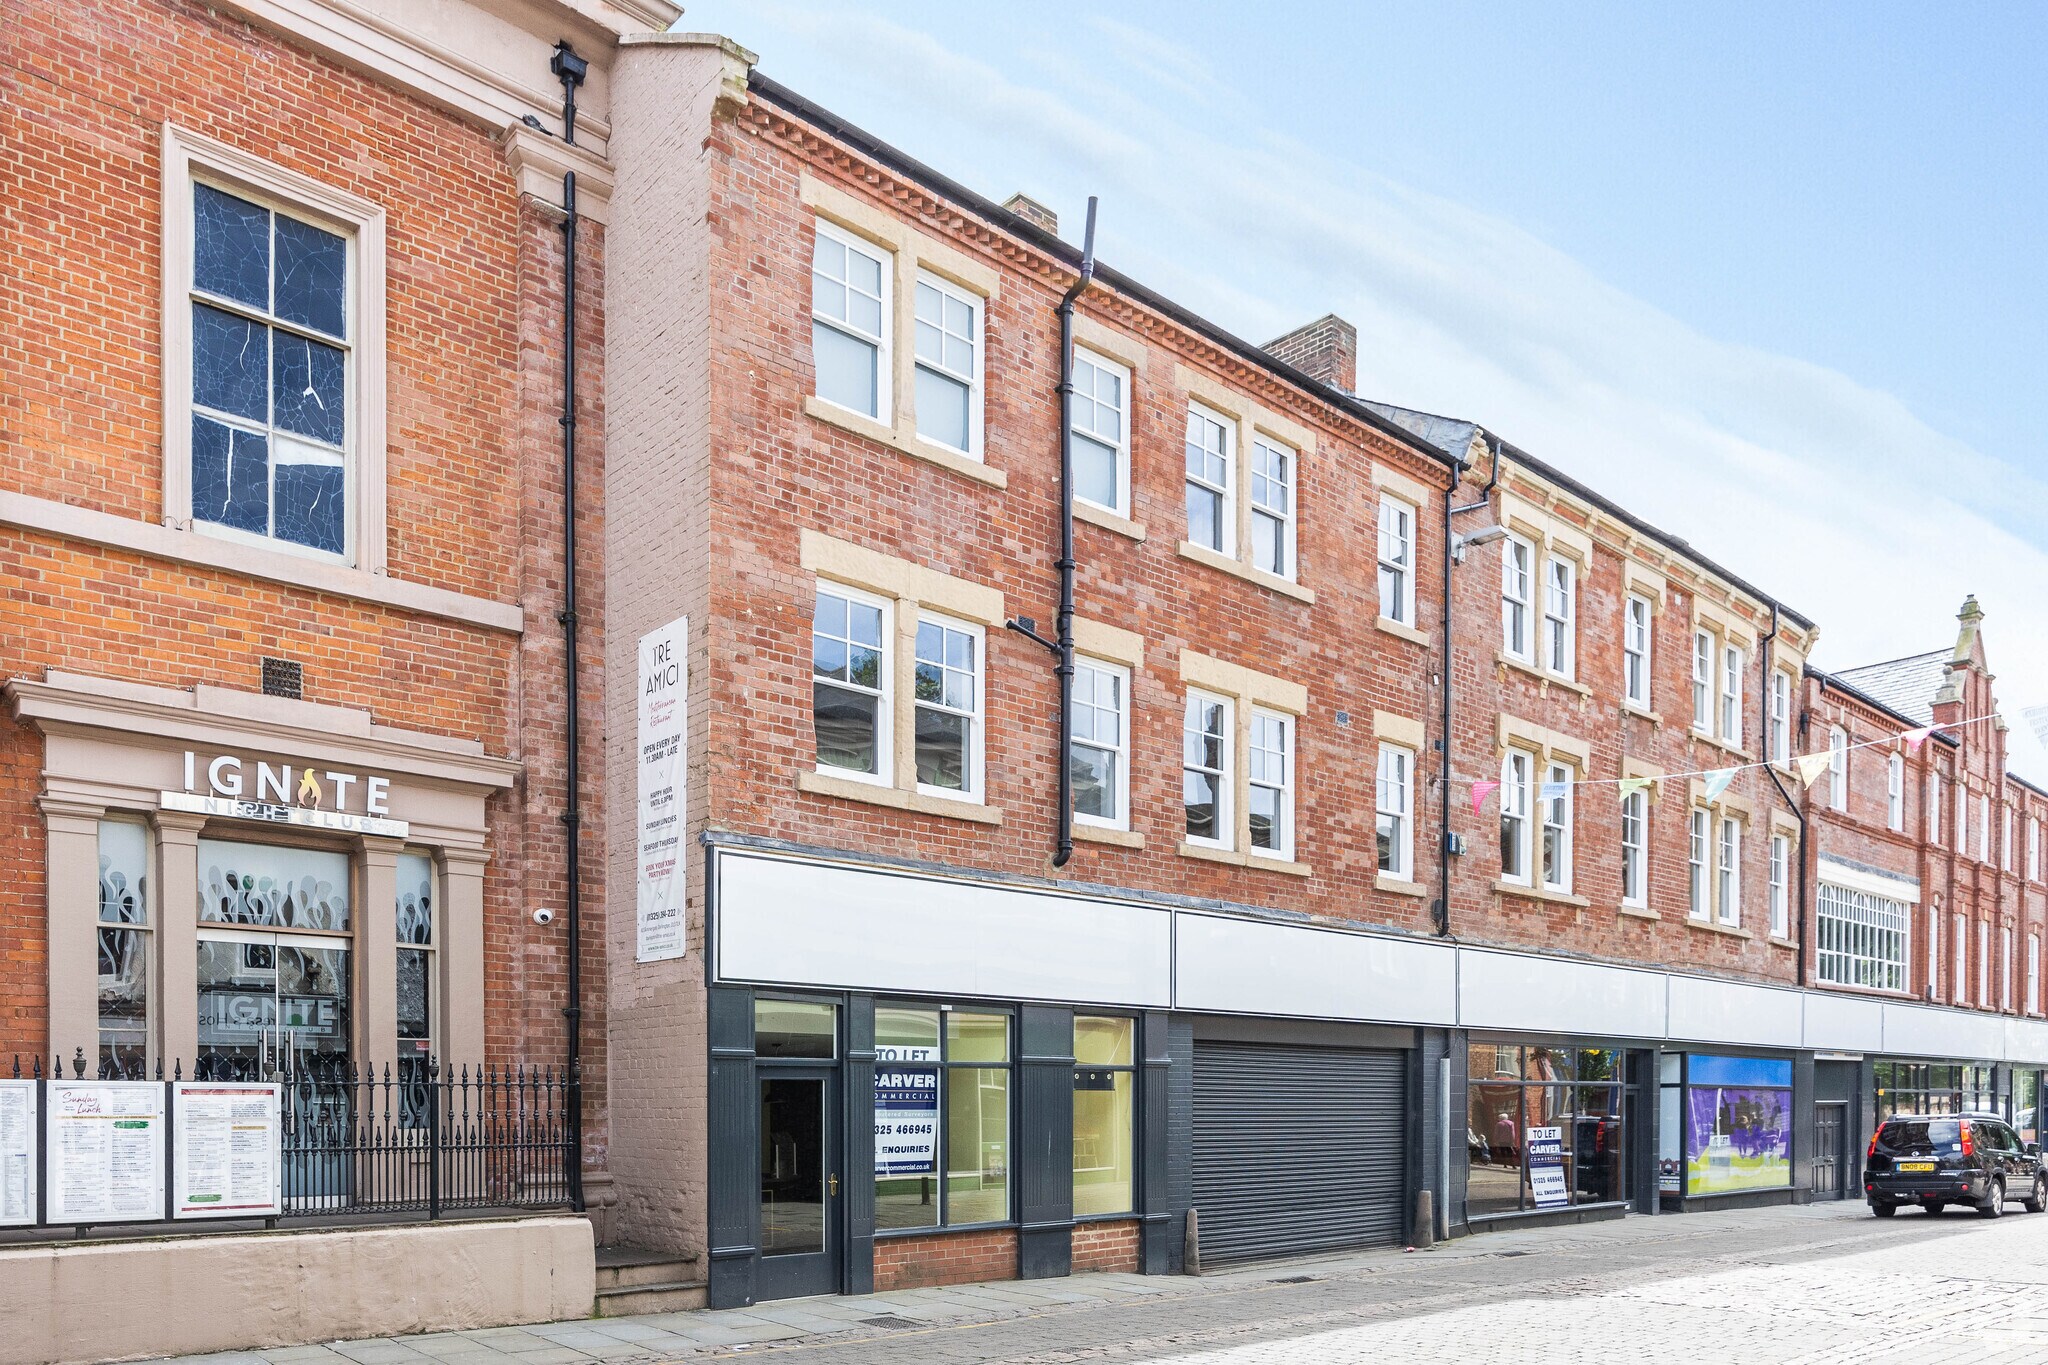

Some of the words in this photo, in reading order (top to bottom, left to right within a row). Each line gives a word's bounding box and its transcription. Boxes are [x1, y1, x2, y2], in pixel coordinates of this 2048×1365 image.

[652, 639, 671, 667] TRE
[645, 662, 679, 697] AMICI
[643, 743, 656, 755] OPEN
[656, 737, 671, 751] EVERY
[671, 733, 681, 745] DAY
[667, 745, 678, 757] LATE
[218, 995, 333, 1026] IGNITE
[875, 1048, 897, 1061] TO
[62, 1091, 98, 1107] Sunday
[875, 1092, 935, 1100] OMMERCIAL
[76, 1103, 102, 1114] Lunch
[896, 1124, 932, 1135] 466945
[1533, 1130, 1542, 1139] TO
[1545, 1129, 1556, 1139] LET
[882, 1145, 930, 1154] ENQUIRIES
[1530, 1145, 1560, 1154] CARVER
